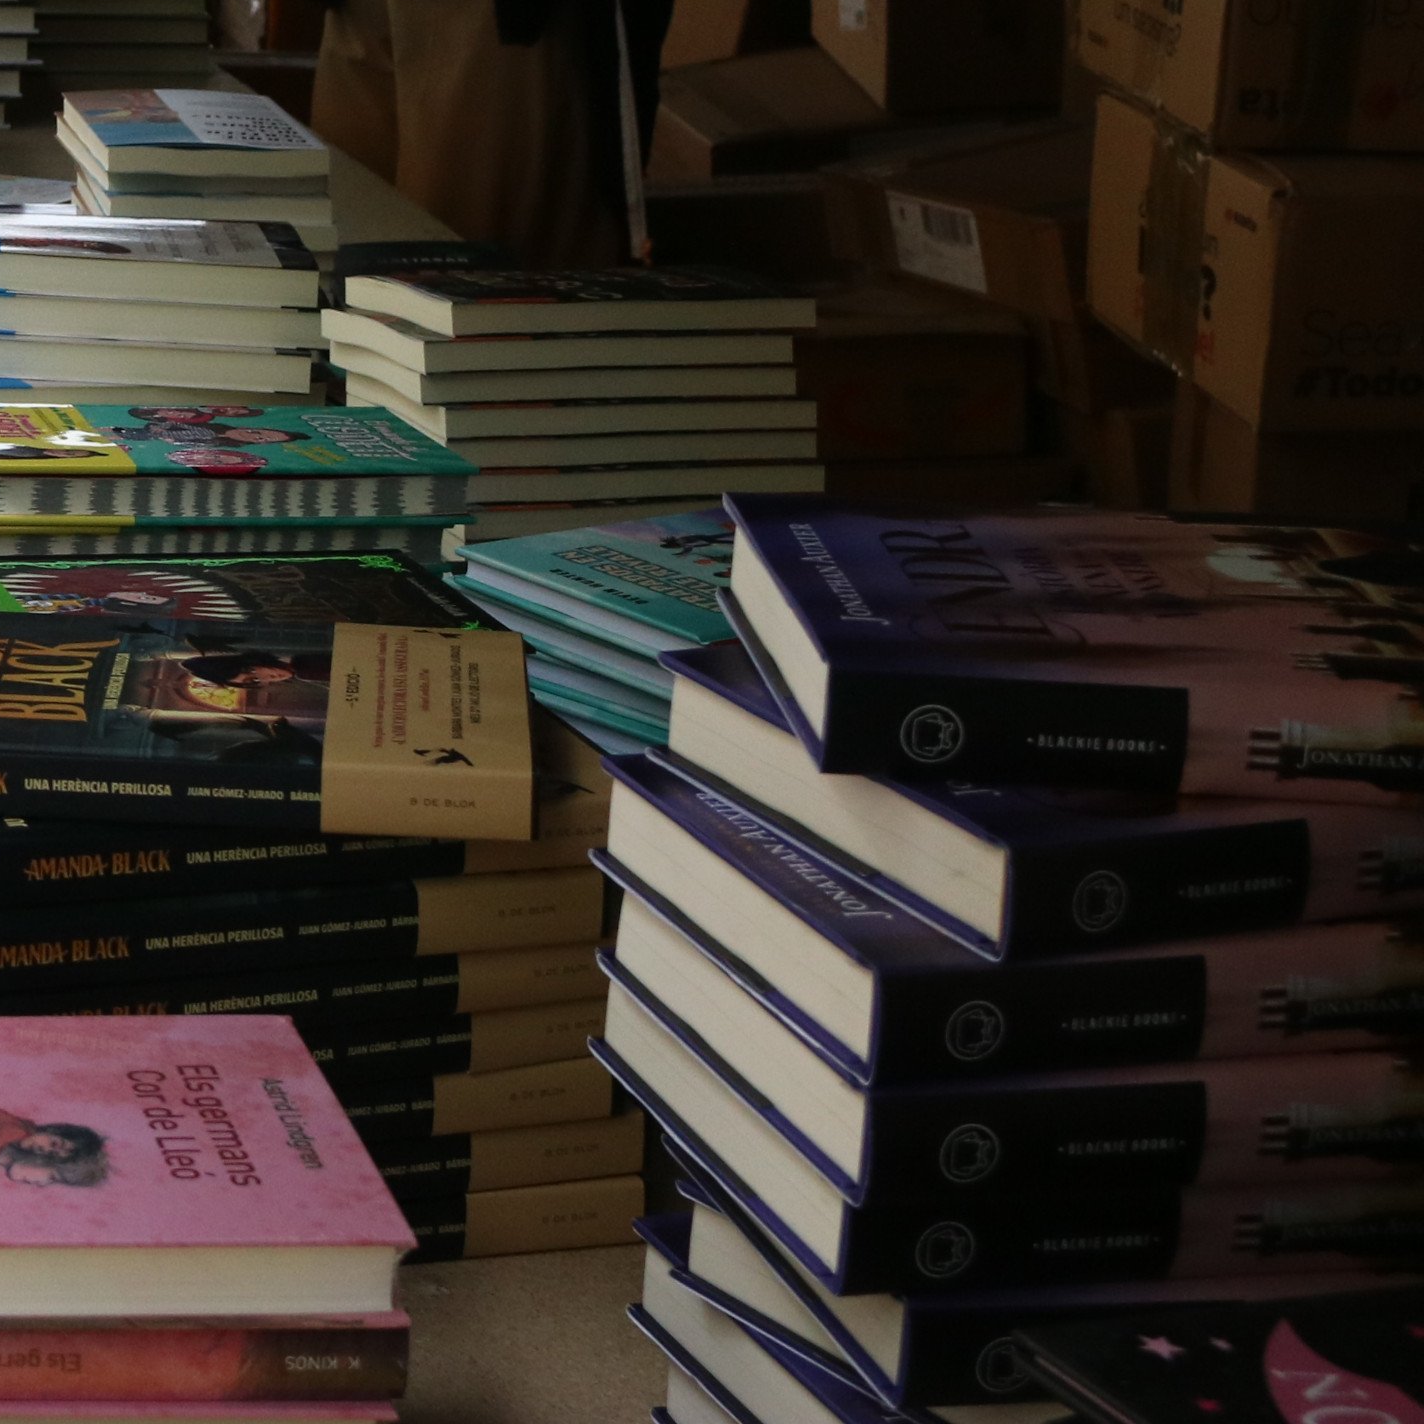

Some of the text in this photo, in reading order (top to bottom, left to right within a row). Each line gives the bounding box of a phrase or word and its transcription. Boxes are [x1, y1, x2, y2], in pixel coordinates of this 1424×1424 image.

[577, 545, 680, 578] ROYALE
[787, 522, 890, 626] JONATHAN AUXIER
[550, 567, 649, 605] DEVIN HUNTER
[1037, 733, 1156, 753] BLACKIE BOOKS
[1298, 743, 1415, 770] JONATHAN
[24, 777, 51, 791] UNA
[52, 776, 109, 794] HERÈNCIA
[111, 782, 172, 796] PERILLOSA
[187, 786, 211, 798] JUAN
[212, 786, 284, 801] GÓMEZ-JURADO
[290, 788, 321, 802] BÁRBA
[423, 798, 440, 808] DE
[444, 798, 476, 808] BLOK
[23, 854, 109, 880] AMANDA
[112, 850, 172, 875] BLACK
[187, 851, 211, 864] UNA
[213, 846, 267, 862] HERÈNCIA
[269, 842, 328, 858] PERILLOSA
[696, 788, 893, 919] JONATHAN AUXIER
[1187, 878, 1243, 899] BLACKIE
[72, 937, 130, 961] BLACK
[145, 937, 170, 950] UNA
[172, 931, 226, 948] HERÈNCIA
[227, 927, 284, 943] PERILLOSA
[299, 925, 320, 936] JUAN
[184, 1001, 208, 1015] UNA
[209, 996, 262, 1013] HERÈNCIA
[263, 988, 318, 1008] PERILLOSA
[332, 986, 353, 997] JUAN
[1070, 1013, 1129, 1031] BLACKIE
[126, 1069, 216, 1180] Cor de Lleó
[176, 1062, 261, 1188] Els germans
[260, 1077, 323, 1170] Astrid Lindgren
[1067, 1139, 1128, 1156] BLACKIE
[48, 1350, 81, 1369] Els
